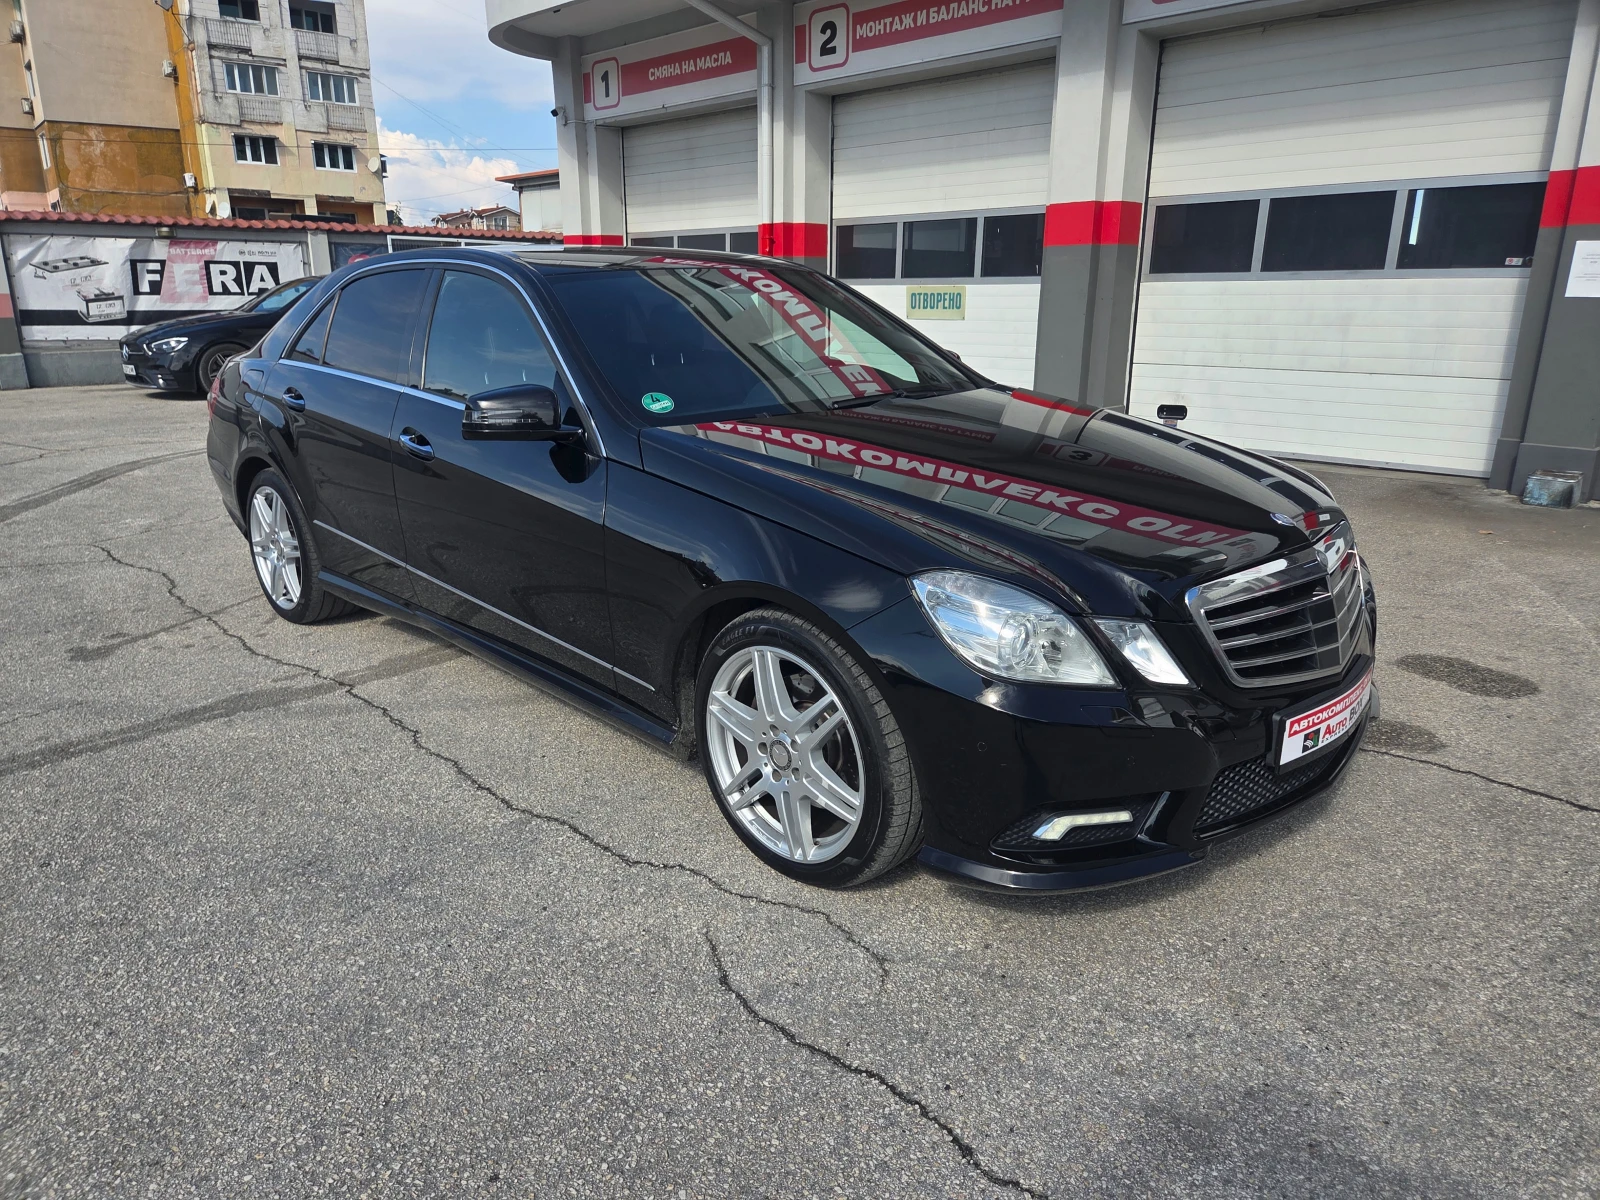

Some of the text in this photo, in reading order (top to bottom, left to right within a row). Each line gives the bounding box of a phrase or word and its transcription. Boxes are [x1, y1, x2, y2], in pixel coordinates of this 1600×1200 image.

[856, 12, 914, 39] МОНТАЖ
[917, 10, 926, 26] И
[929, 0, 989, 24] БАЛАНС
[820, 20, 838, 57] 2
[648, 51, 732, 81] СМЯНА НА МАСЛА
[600, 70, 610, 98] 1
[136, 262, 277, 294] FERA
[910, 292, 962, 310] ОТВОРЕНО
